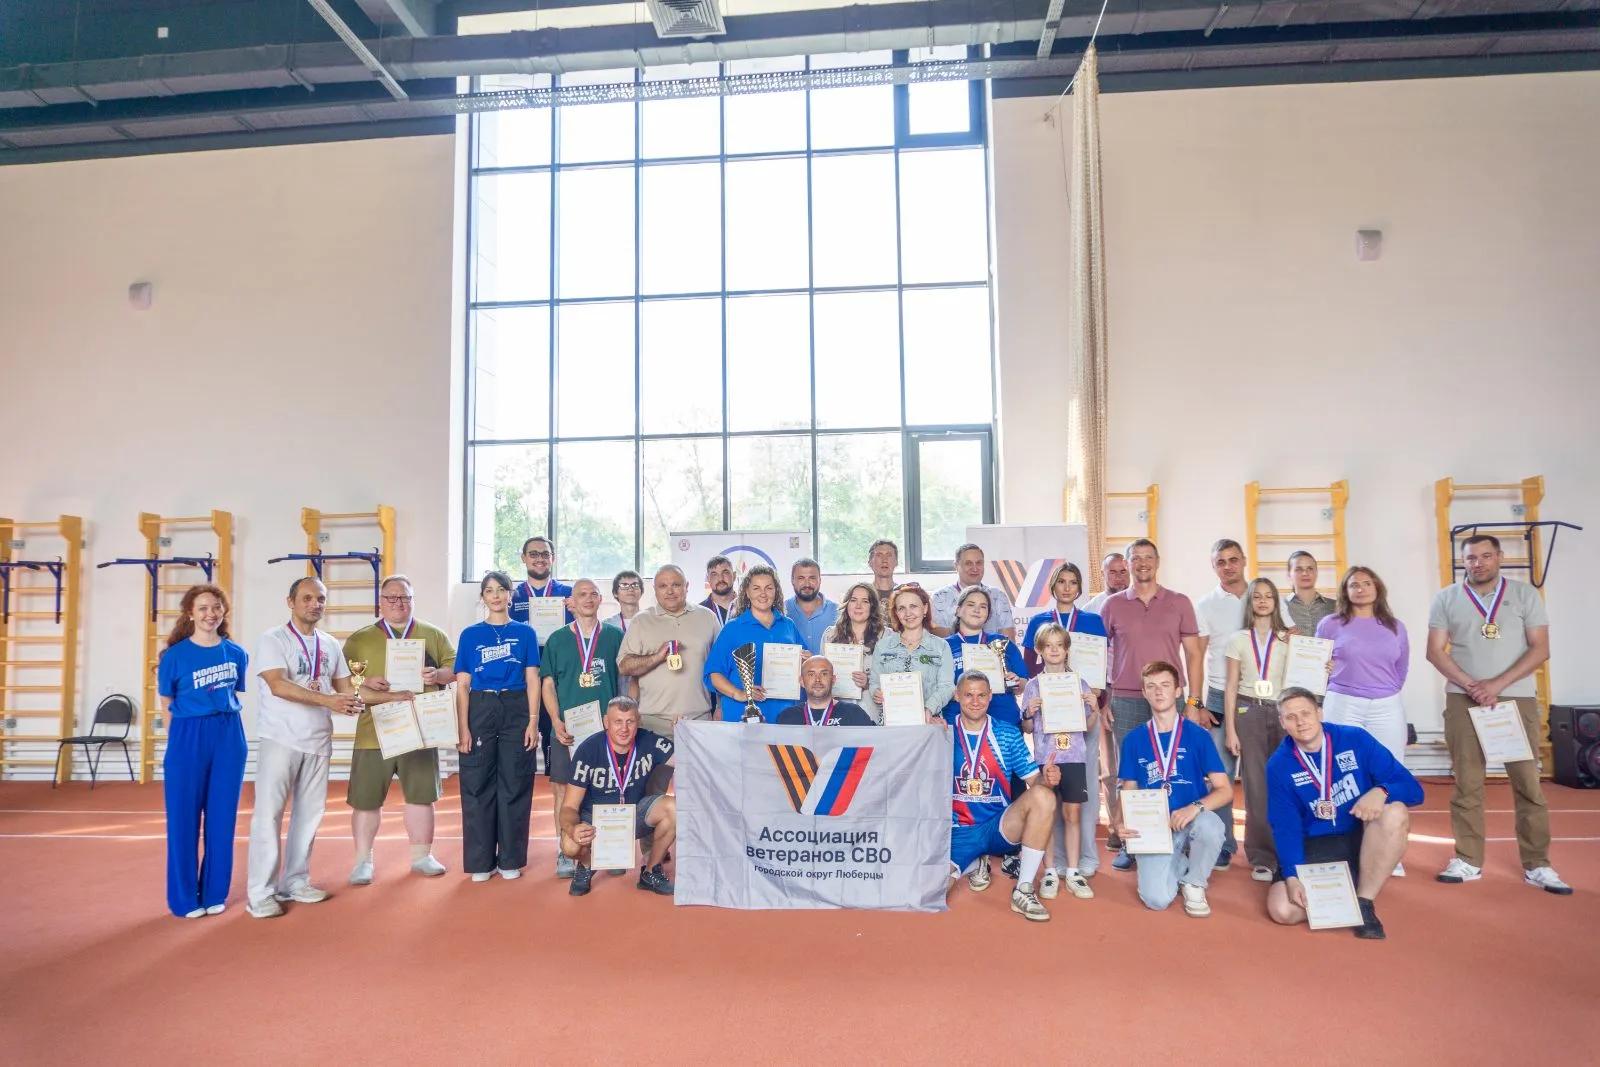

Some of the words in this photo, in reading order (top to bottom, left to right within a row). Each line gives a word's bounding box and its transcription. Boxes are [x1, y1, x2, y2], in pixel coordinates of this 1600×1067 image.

[759, 826, 878, 846] Ассоциация
[746, 845, 846, 865] ветеранов
[851, 847, 892, 864] СВО
[754, 864, 803, 878] городской
[806, 870, 833, 880] округ
[835, 869, 884, 880] Люберцы
